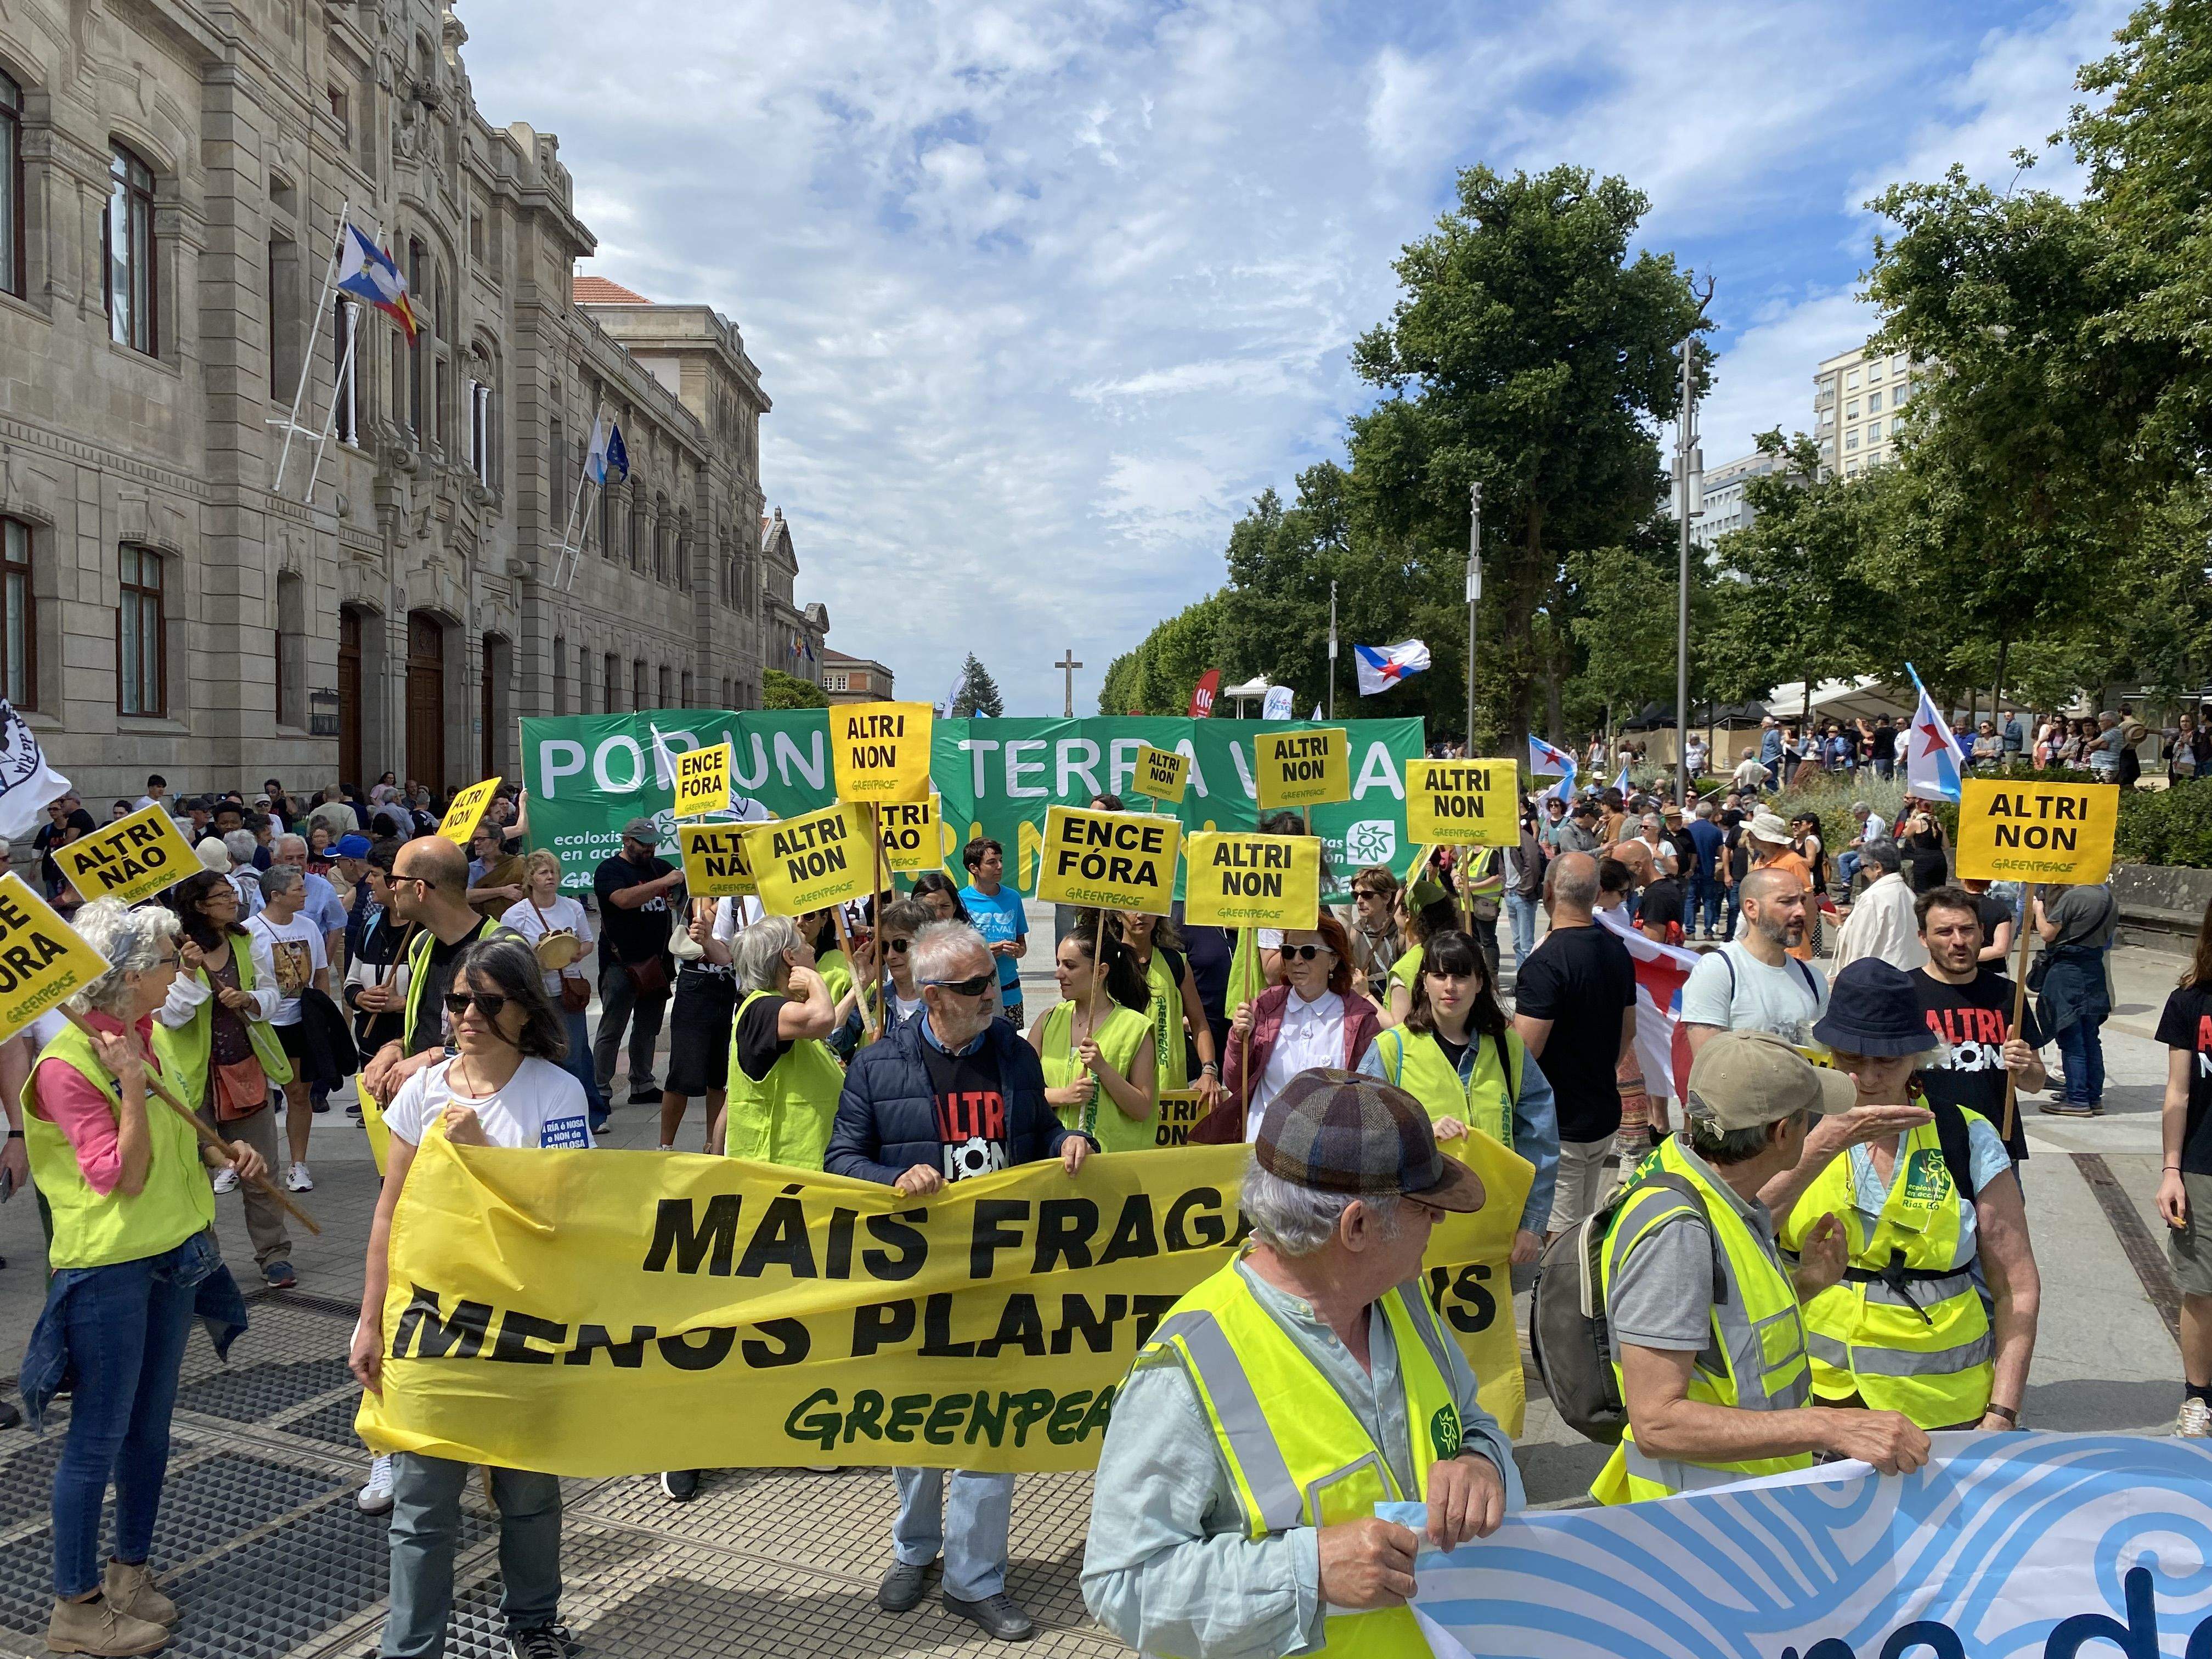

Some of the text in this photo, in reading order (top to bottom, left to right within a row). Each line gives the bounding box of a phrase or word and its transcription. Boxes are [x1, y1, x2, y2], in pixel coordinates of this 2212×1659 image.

[847, 715, 905, 740] ALTRI
[853, 744, 896, 769] NON
[1274, 736, 1329, 760] ALTRI
[682, 751, 723, 777] ENCE
[1148, 752, 1180, 771] ALTRI
[1282, 759, 1324, 782] NON
[681, 774, 723, 799] FÓRA
[852, 779, 899, 792] GREENPEACE
[1150, 767, 1175, 785] NON
[1425, 769, 1491, 792] ALTRI
[452, 788, 487, 811] ALTRI
[1280, 788, 1327, 800] GREENPEACE
[879, 804, 929, 827] TRI
[1434, 795, 1485, 818] NON
[1987, 793, 2089, 821] ALTRI
[445, 808, 475, 830] NON
[554, 830, 624, 846] ecoloxis
[691, 833, 743, 855] ALT
[773, 814, 848, 859] ALTRI
[883, 826, 921, 850] ÃO
[1062, 816, 1165, 854] ENCE
[1432, 828, 1488, 838] GREENPEACE
[1994, 824, 2078, 851] NON
[73, 817, 165, 876] ALTRI
[561, 850, 583, 861] en
[1212, 842, 1292, 869] ALTRI
[97, 846, 167, 890] NÃO
[705, 853, 753, 877] NÃ
[787, 845, 848, 884] NON
[1057, 848, 1159, 888] FÓRA
[1991, 858, 2078, 873] GREENPEACE
[709, 883, 756, 893] GREENPEA
[793, 880, 855, 906] GREENPEACE
[1222, 871, 1283, 898] NON
[1065, 887, 1144, 906] GREENPEACE
[1217, 907, 1284, 919] GREENPEACE
[1155, 996, 1170, 1070] GREENPEACE
[1159, 1099, 1198, 1121] TRI
[566, 1119, 585, 1129] NOSA
[1155, 1124, 1188, 1146] ON
[554, 1131, 571, 1142] NON
[642, 1183, 928, 1281] MÁIS
[392, 1282, 811, 1370] MENOS
[784, 1385, 1116, 1452] GREENPEA
